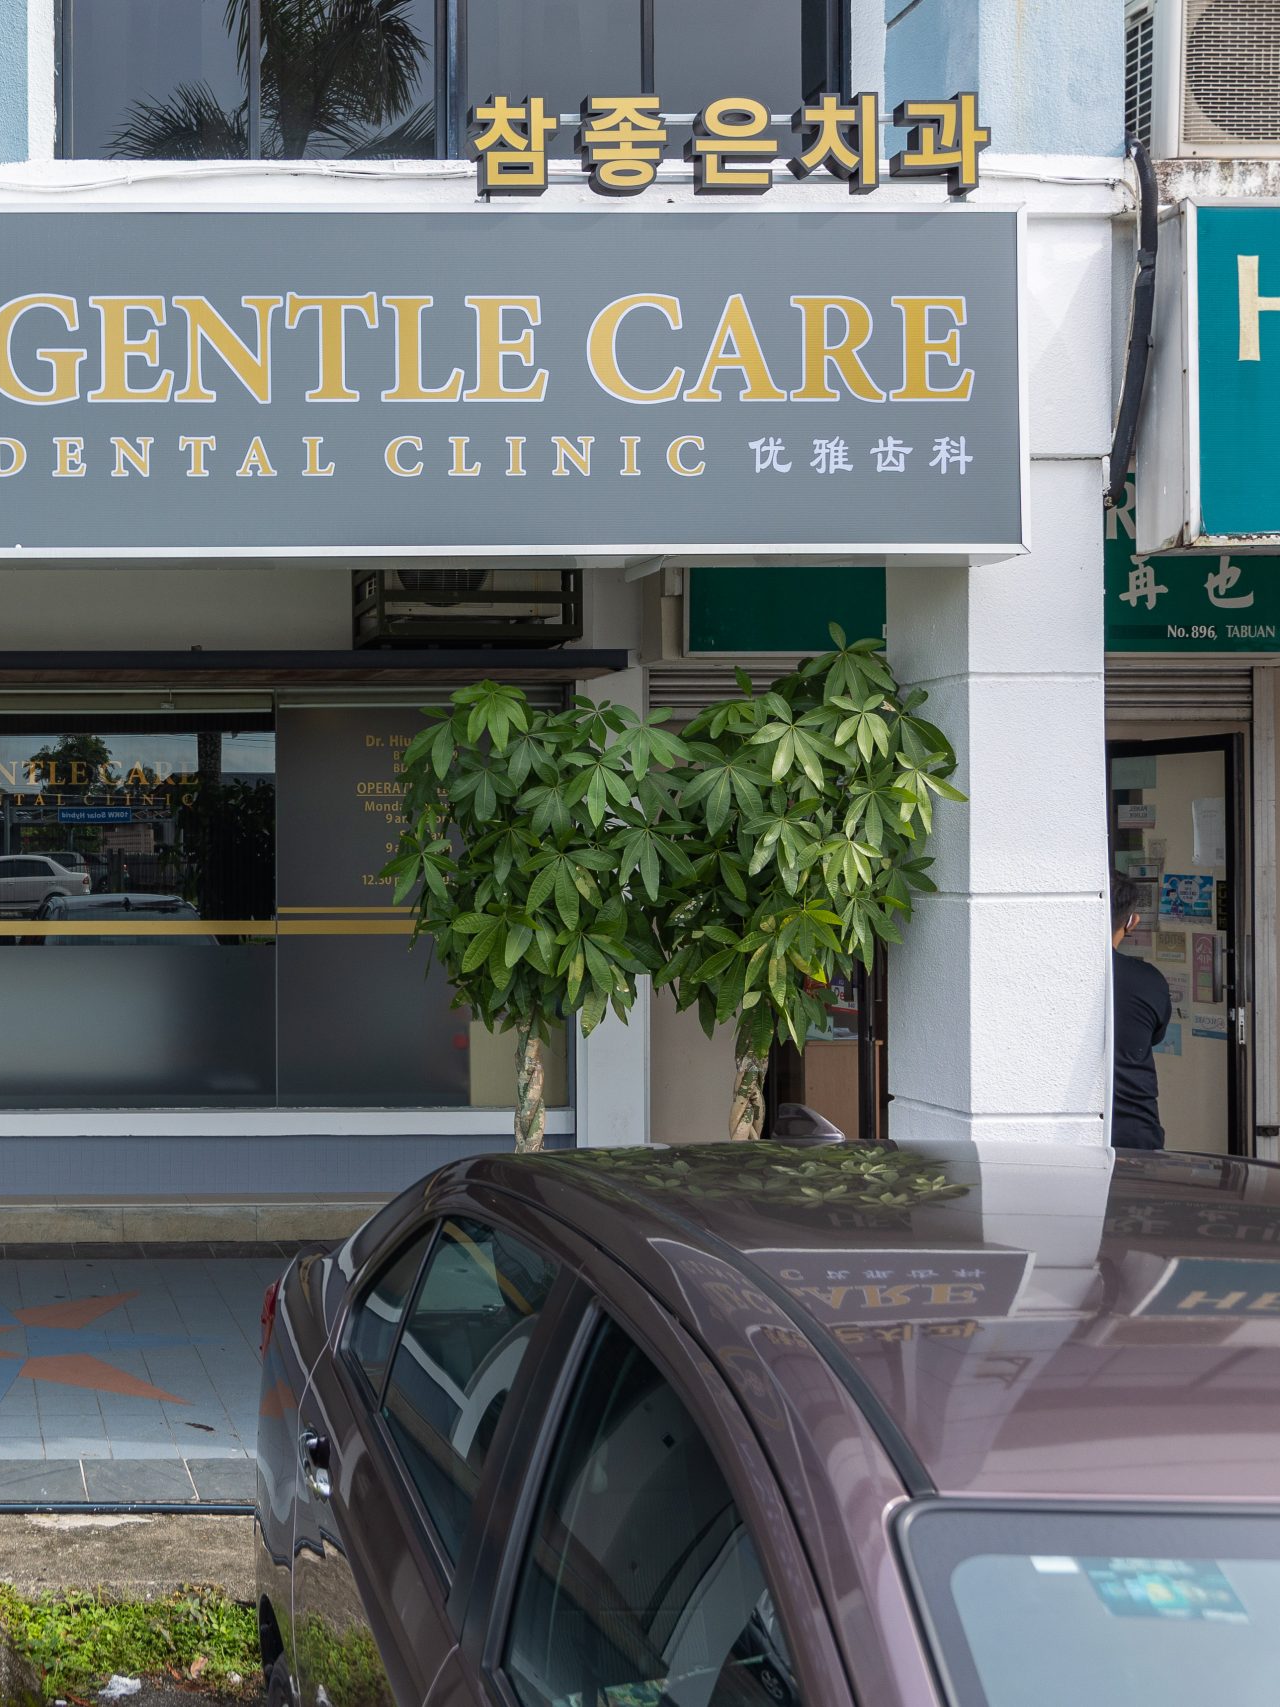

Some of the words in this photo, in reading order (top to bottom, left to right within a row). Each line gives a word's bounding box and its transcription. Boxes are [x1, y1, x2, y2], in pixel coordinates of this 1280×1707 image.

[586, 292, 976, 404] CARE
[384, 435, 706, 477] CLINIC
[748, 435, 974, 475] 优雅齿科
[1225, 625, 1276, 639] TABUAN
[365, 735, 385, 747] Dr.
[100, 759, 200, 786] CARE
